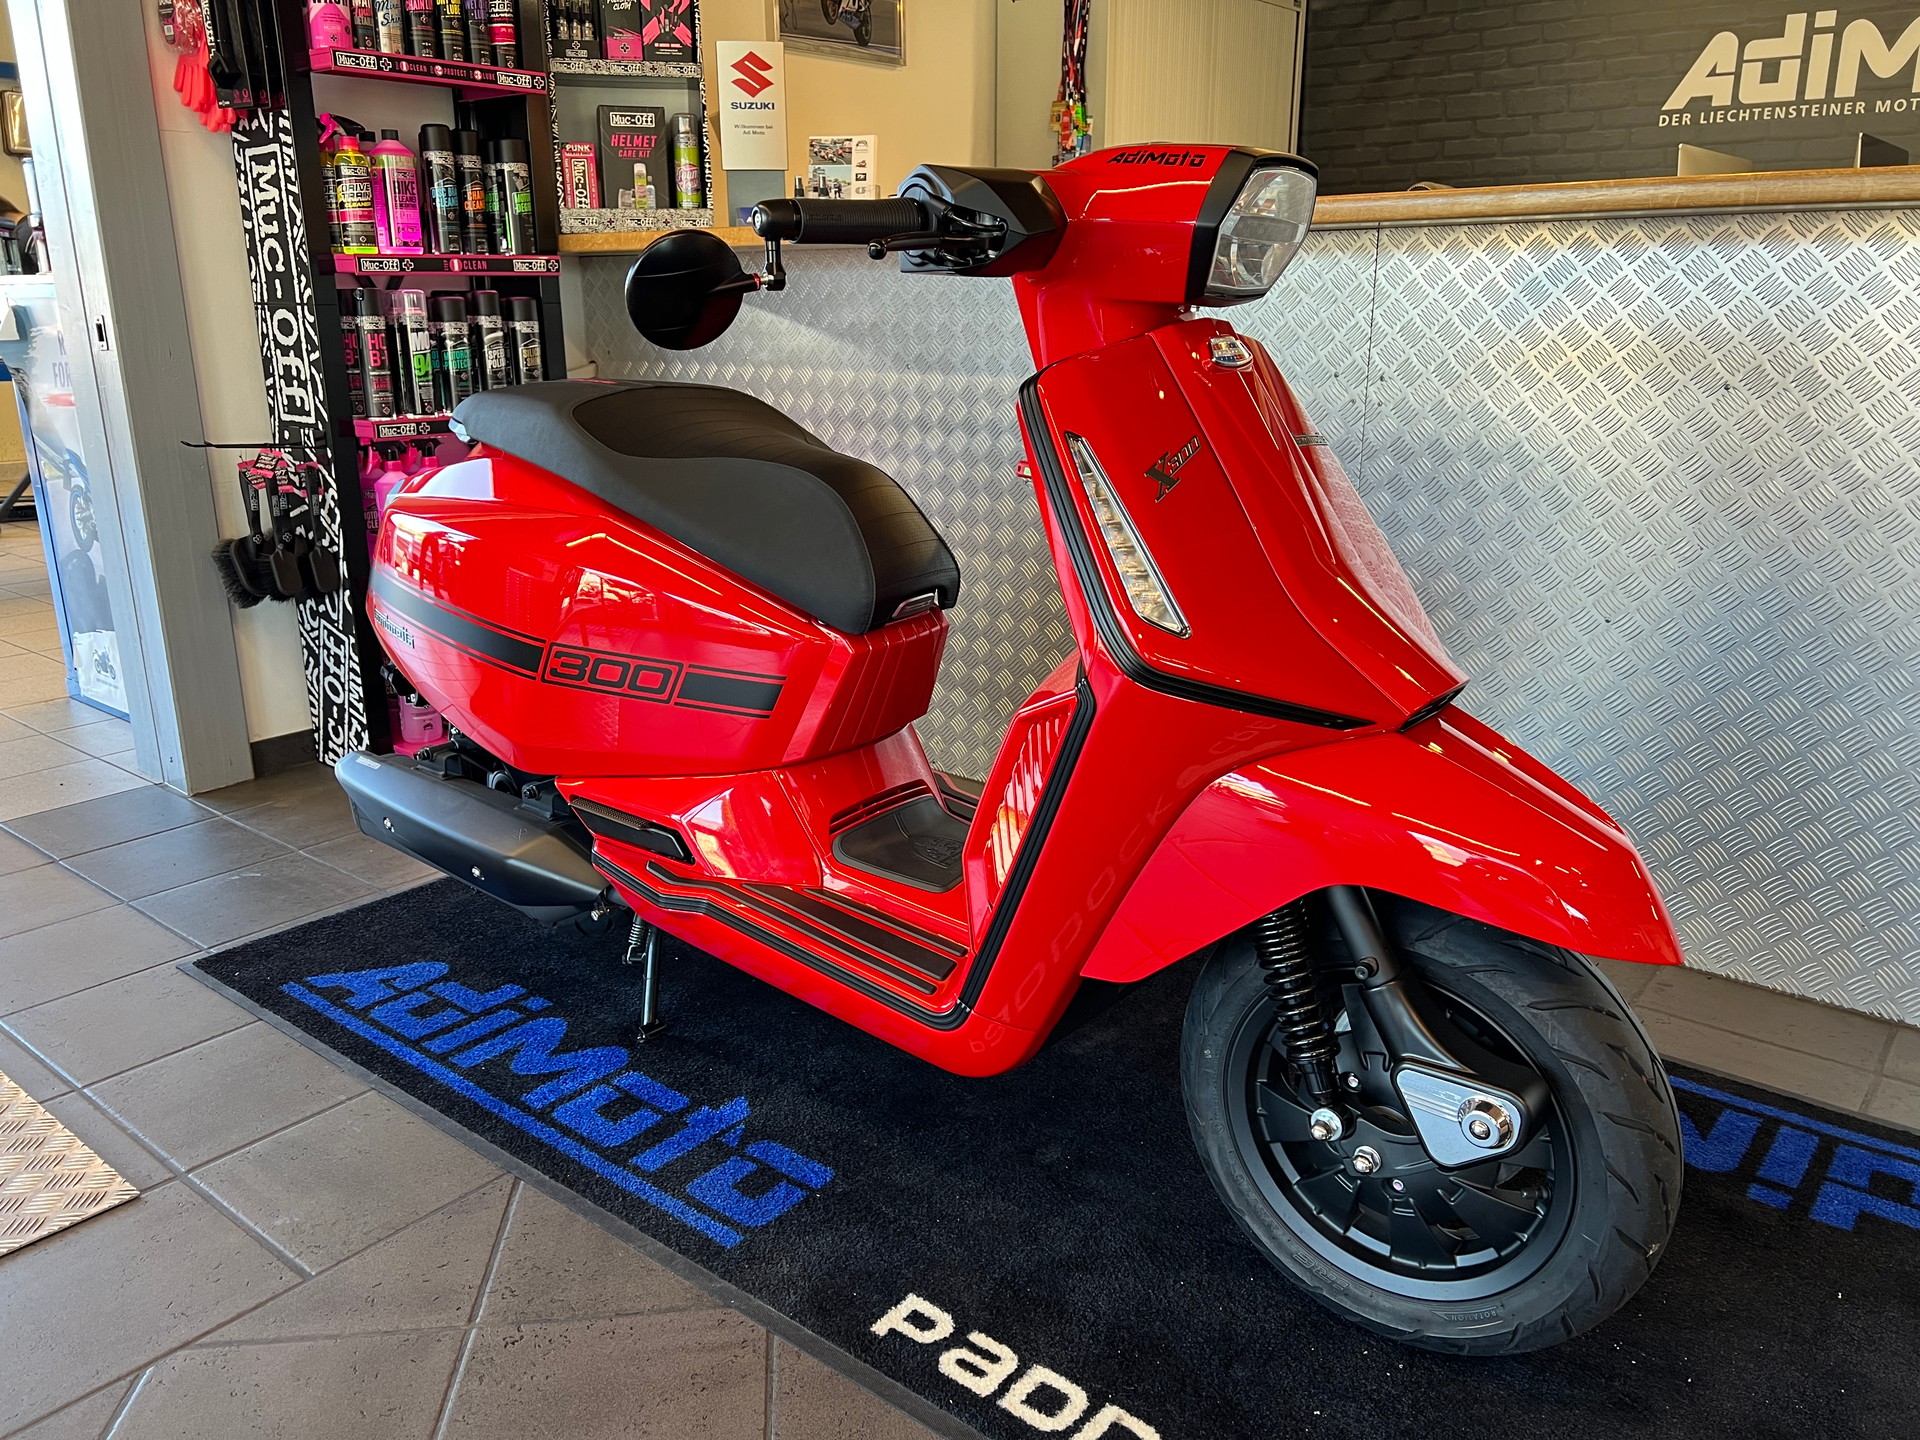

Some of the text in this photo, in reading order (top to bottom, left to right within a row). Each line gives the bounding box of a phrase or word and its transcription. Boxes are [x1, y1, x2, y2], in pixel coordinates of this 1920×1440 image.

[338, 54, 376, 68] Muc-Off
[499, 74, 531, 87] Muc-Off
[731, 102, 775, 110] SUZUKI
[613, 114, 653, 125] Muc-Off
[1658, 114, 1691, 127] DER
[1700, 101, 1865, 124] LIECHTENSTEINER
[611, 134, 657, 147] HELMET
[566, 144, 591, 152] PUNK
[618, 150, 651, 158] CARE KIT
[1107, 150, 1207, 167] AdiMoto
[342, 183, 370, 192] DRIVE
[574, 160, 588, 208] Muc-Off
[342, 192, 371, 200] TRAIN
[363, 260, 398, 271] Muc-Off
[463, 260, 487, 270] CLEAN
[515, 260, 545, 271] Muc-Off
[251, 160, 309, 412] Muc-Off
[381, 424, 416, 435] Muc-Off
[550, 651, 673, 695] 300
[307, 961, 835, 1229] AdiMoto
